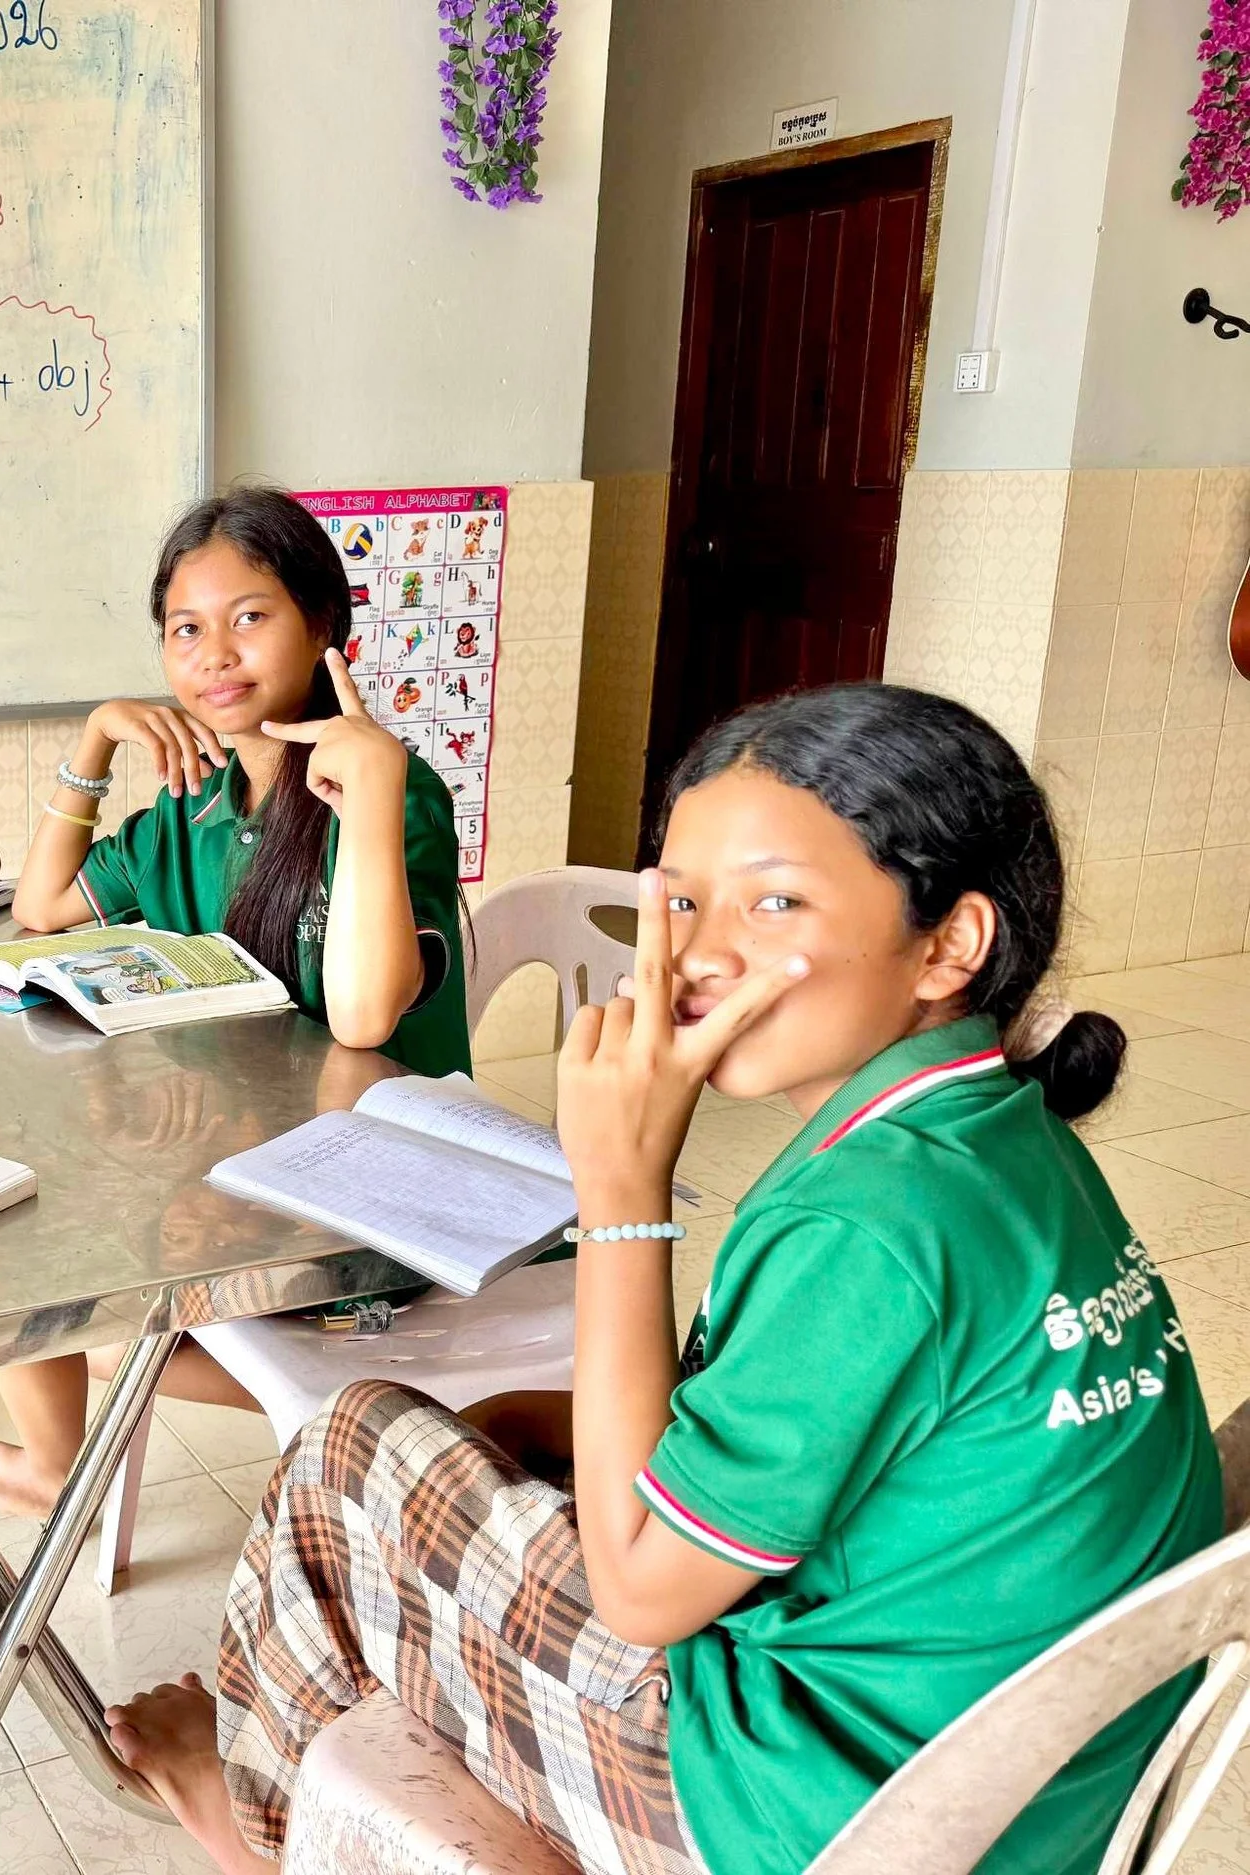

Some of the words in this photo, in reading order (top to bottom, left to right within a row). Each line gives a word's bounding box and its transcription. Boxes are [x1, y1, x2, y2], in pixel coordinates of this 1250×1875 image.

[778, 134, 801, 146] BOY'S
[802, 128, 827, 141] ROOM
[38, 338, 90, 417] obj
[297, 496, 375, 513] ENGLISH
[384, 492, 472, 509] ALPHABET
[331, 519, 341, 533] B
[376, 517, 384, 532] b
[391, 517, 402, 530] C
[437, 519, 444, 529] c
[450, 514, 461, 529] D
[494, 513, 501, 527] d
[377, 571, 383, 585] f
[389, 570, 400, 584] G
[434, 572, 441, 586] g
[448, 567, 459, 581] H
[488, 565, 495, 579] h
[371, 625, 377, 642] j
[387, 624, 398, 638] K
[427, 622, 435, 636] k
[444, 620, 454, 634] L
[368, 680, 376, 690] n
[382, 675, 393, 689] O
[427, 676, 434, 686] o
[441, 672, 450, 685] P
[481, 673, 489, 686] p
[437, 723, 447, 736] T
[483, 722, 488, 732] t
[469, 819, 477, 834] 5
[464, 850, 477, 865] 10
[1047, 1366, 1164, 1428] Asia's
